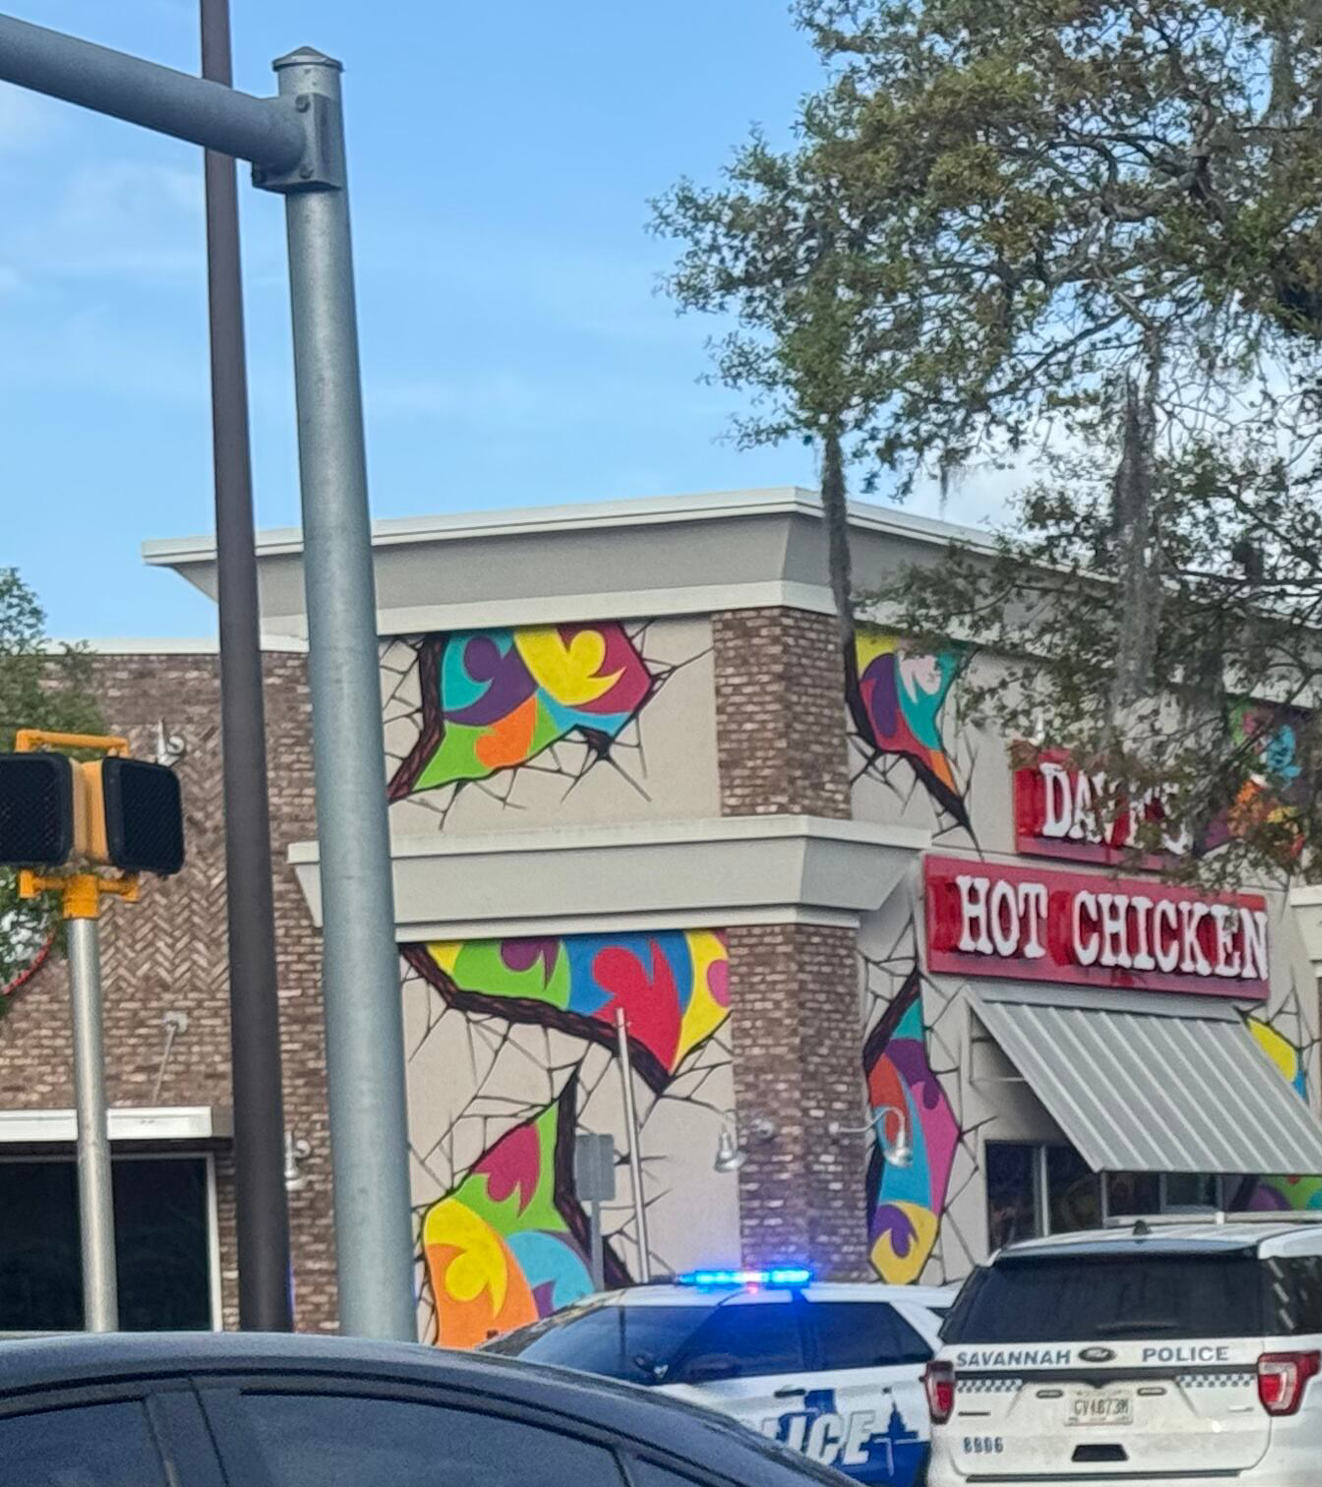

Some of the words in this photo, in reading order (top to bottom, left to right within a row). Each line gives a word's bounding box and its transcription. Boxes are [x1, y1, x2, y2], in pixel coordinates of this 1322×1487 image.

[956, 875, 1047, 959] HOT
[1073, 889, 1268, 981] CHICKEN
[956, 1350, 1071, 1367] SAVANNAH
[1142, 1346, 1229, 1363] POLICE
